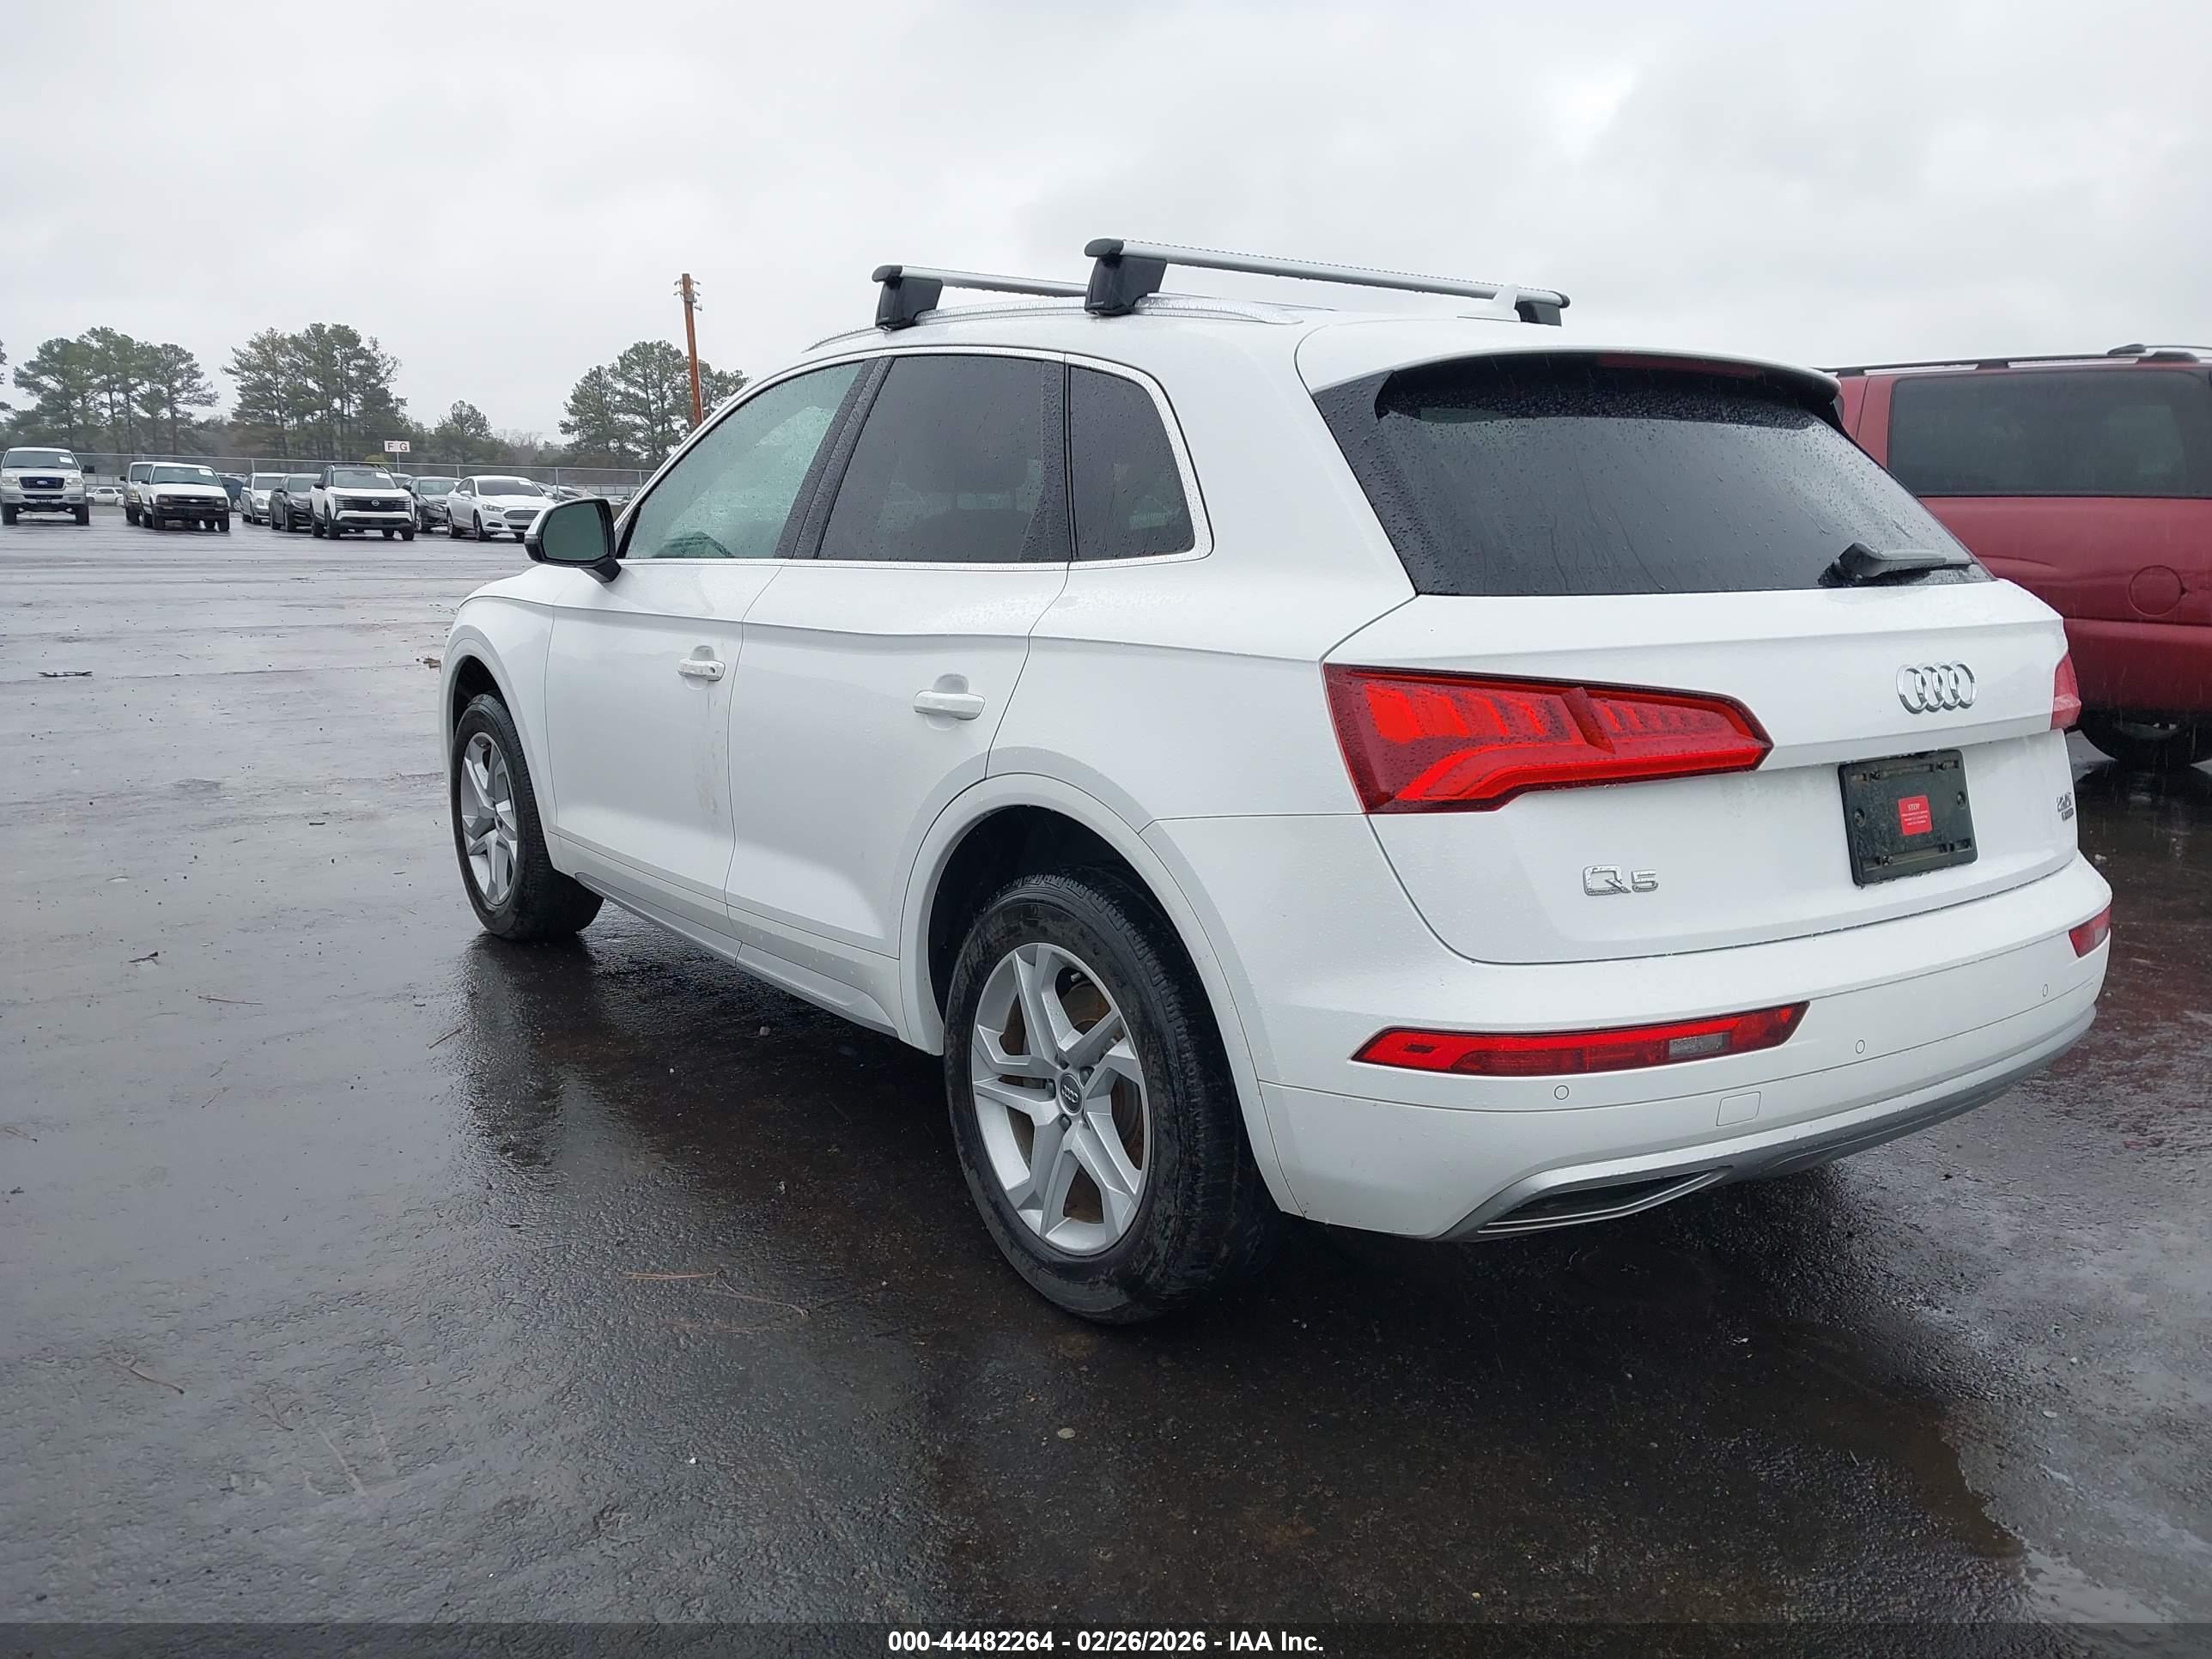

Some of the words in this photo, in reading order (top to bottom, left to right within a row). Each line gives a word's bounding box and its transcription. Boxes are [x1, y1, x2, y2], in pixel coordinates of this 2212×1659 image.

[387, 442, 394, 451] F
[399, 442, 408, 451] G
[1583, 865, 1658, 896] Q5
